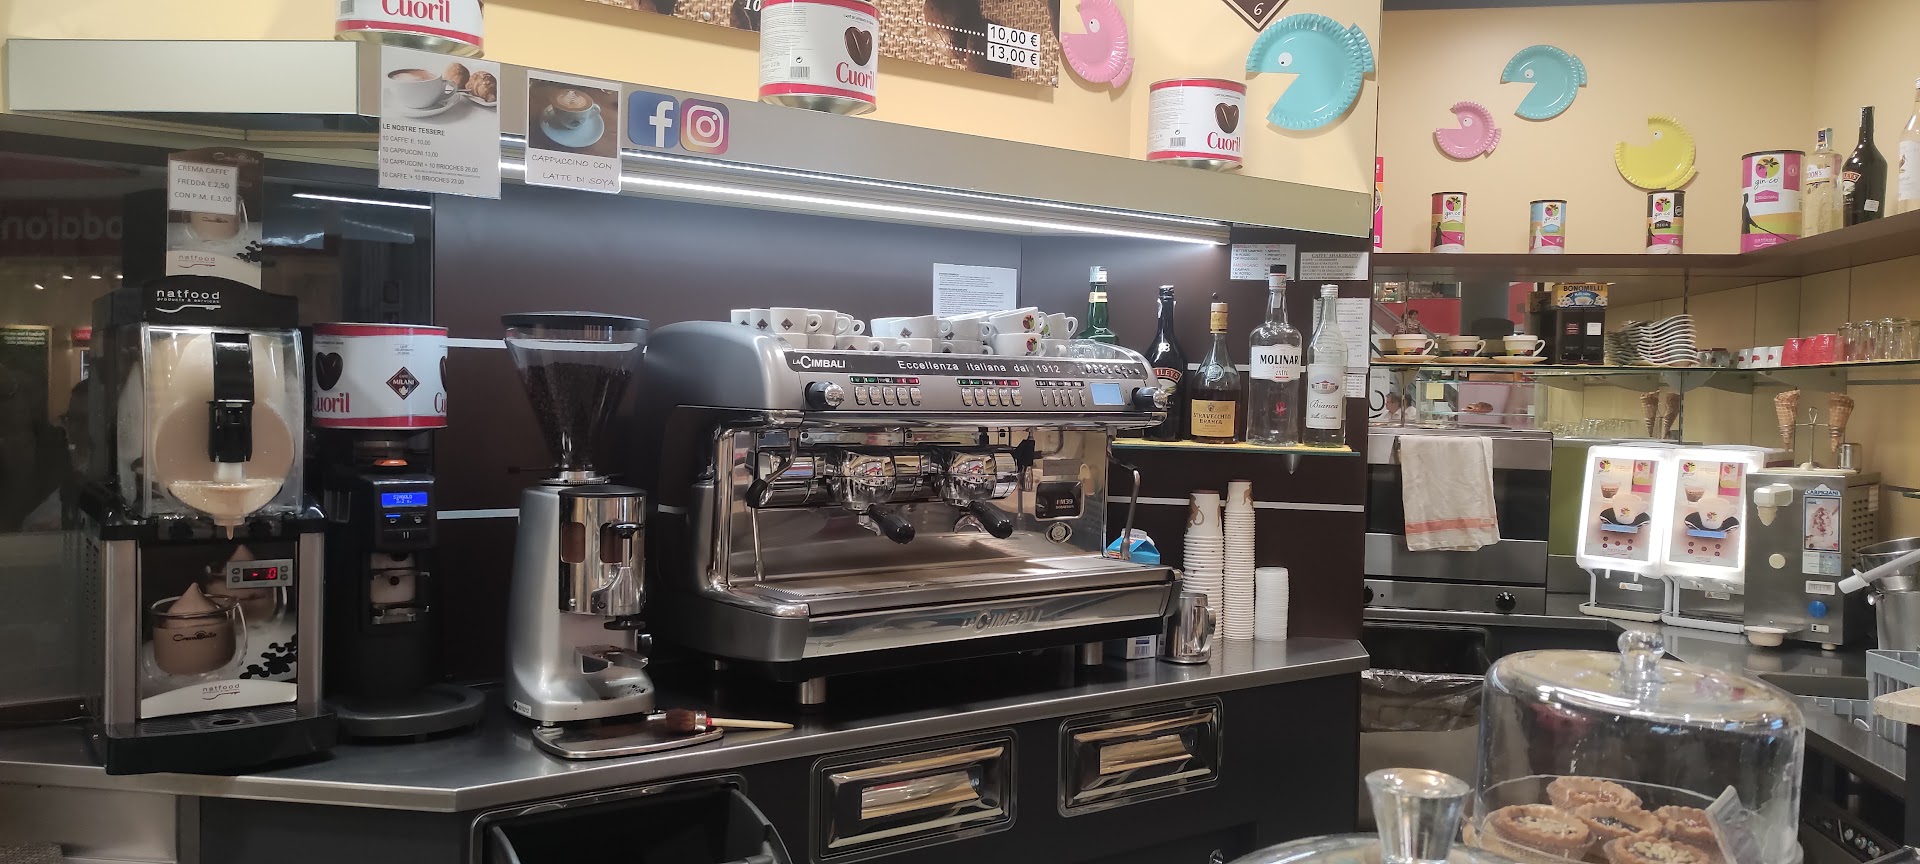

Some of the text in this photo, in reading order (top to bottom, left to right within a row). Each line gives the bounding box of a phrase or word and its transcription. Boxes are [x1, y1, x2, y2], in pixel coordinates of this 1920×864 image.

[1253, 2, 1264, 16] 6
[990, 26, 1038, 47] 10,00 €
[990, 44, 1038, 66] 13,00 €
[835, 61, 875, 90] Cuoril
[391, 124, 417, 133] NOSTRE
[418, 127, 446, 137] TESSERE
[1207, 131, 1241, 152] Cuoril
[389, 147, 424, 157] CAPPUCCINI
[177, 164, 204, 173] CREMA
[389, 158, 424, 168] CAPPUCCINI
[436, 163, 464, 172] BRIOCHES
[531, 154, 613, 170] CAPPUCCINO CON
[177, 178, 206, 187] FREDDA
[421, 175, 450, 184] BRIOCHES
[542, 172, 572, 182] LATTE
[588, 177, 615, 188] SOYA
[174, 191, 191, 199] CON
[178, 254, 216, 262] natfood
[156, 289, 220, 300] natfood
[897, 360, 1061, 374] Eccellenza italiana dal 1912
[1309, 399, 1339, 410] Bianca
[202, 684, 240, 693] natfood
